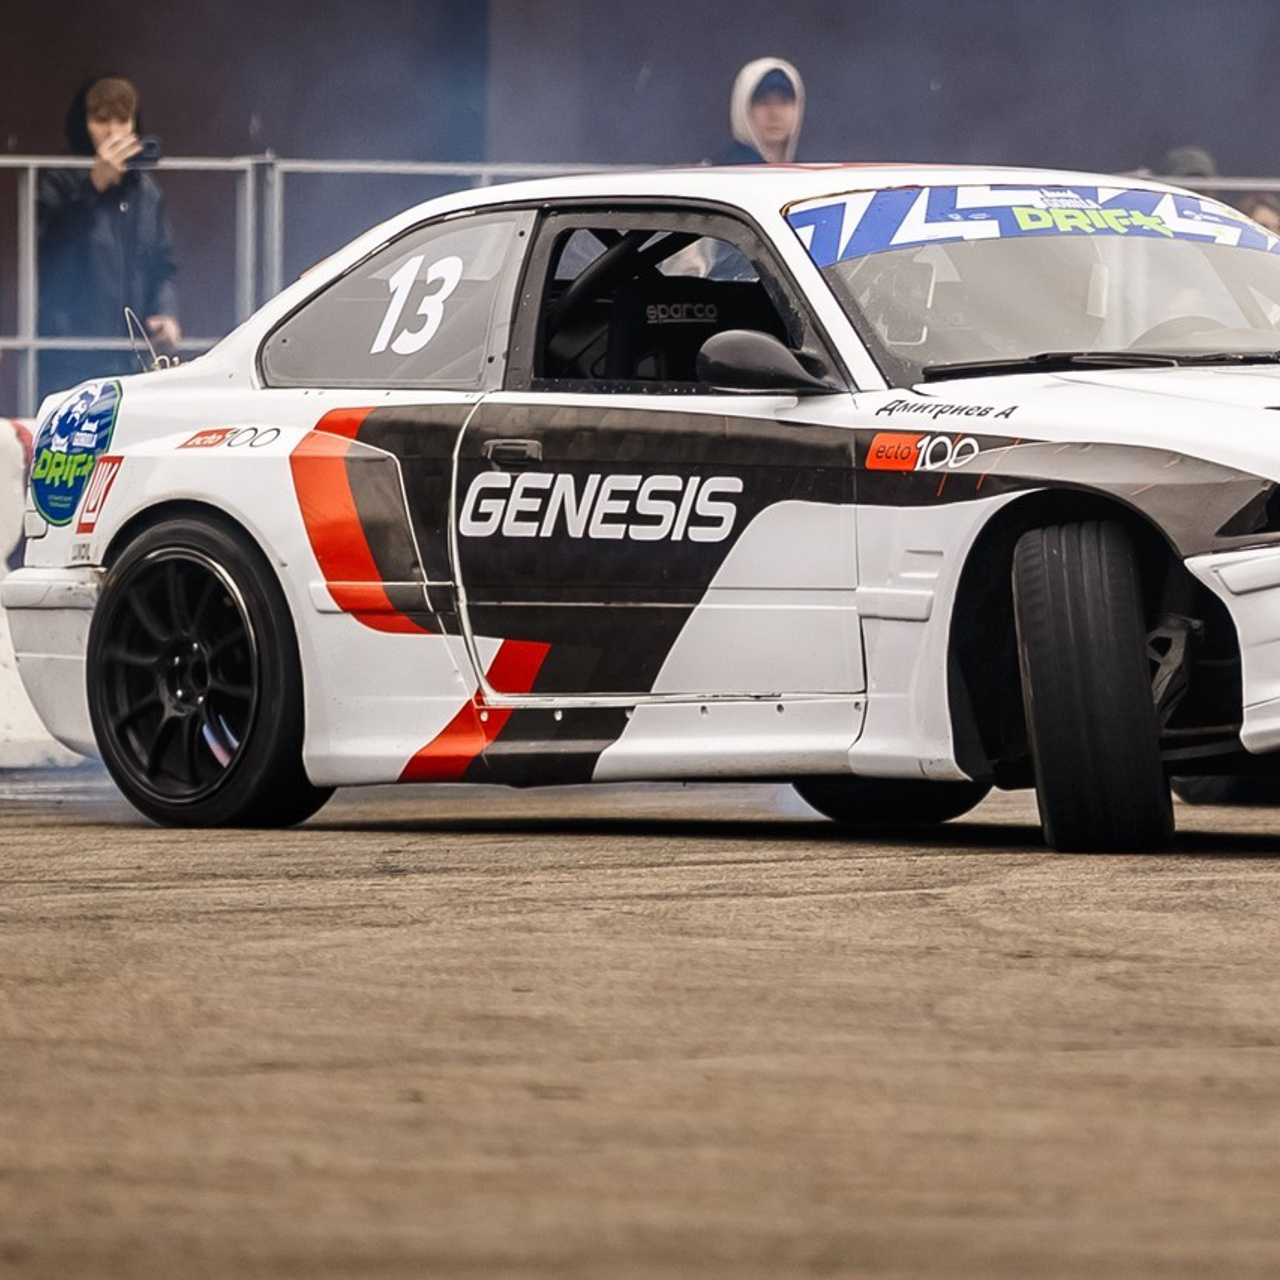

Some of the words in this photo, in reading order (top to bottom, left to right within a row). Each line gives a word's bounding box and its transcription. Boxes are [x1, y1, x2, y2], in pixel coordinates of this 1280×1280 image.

[1012, 206, 1174, 237] DRIFT
[369, 254, 464, 355] 13
[875, 400, 994, 419] Дмитриев
[459, 471, 744, 542] GENESIS
